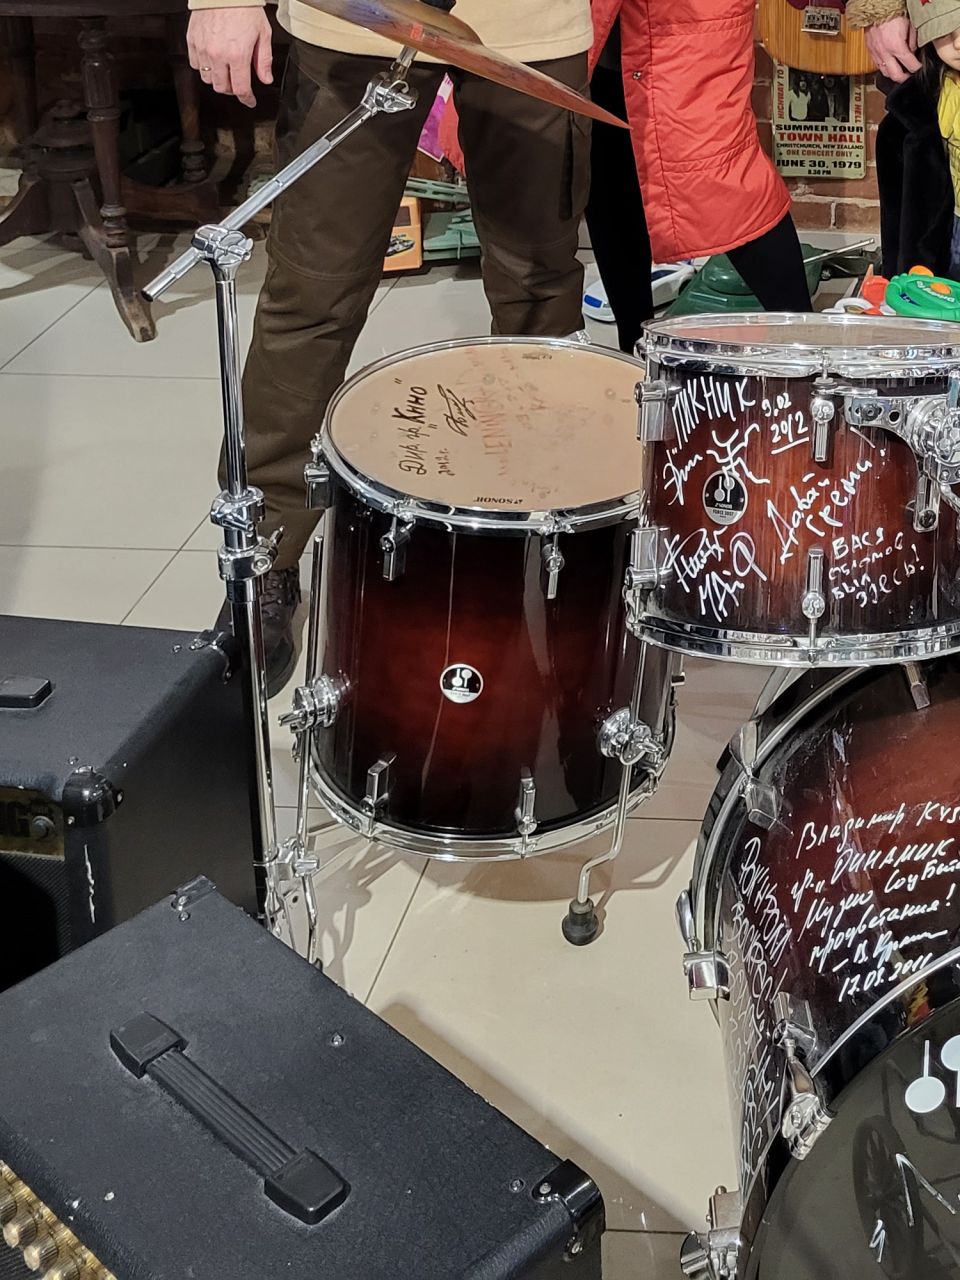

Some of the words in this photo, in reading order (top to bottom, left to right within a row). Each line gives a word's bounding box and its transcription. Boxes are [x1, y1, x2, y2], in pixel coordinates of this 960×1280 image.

[775, 124, 829, 132] SUMMER
[832, 125, 864, 133] TOUR
[777, 132, 824, 142] TOWN
[828, 133, 863, 144] HALL
[801, 149, 834, 157] CONCERT
[835, 150, 853, 158] ONLY
[776, 159, 806, 168] JUNE
[832, 160, 862, 169] 1979
